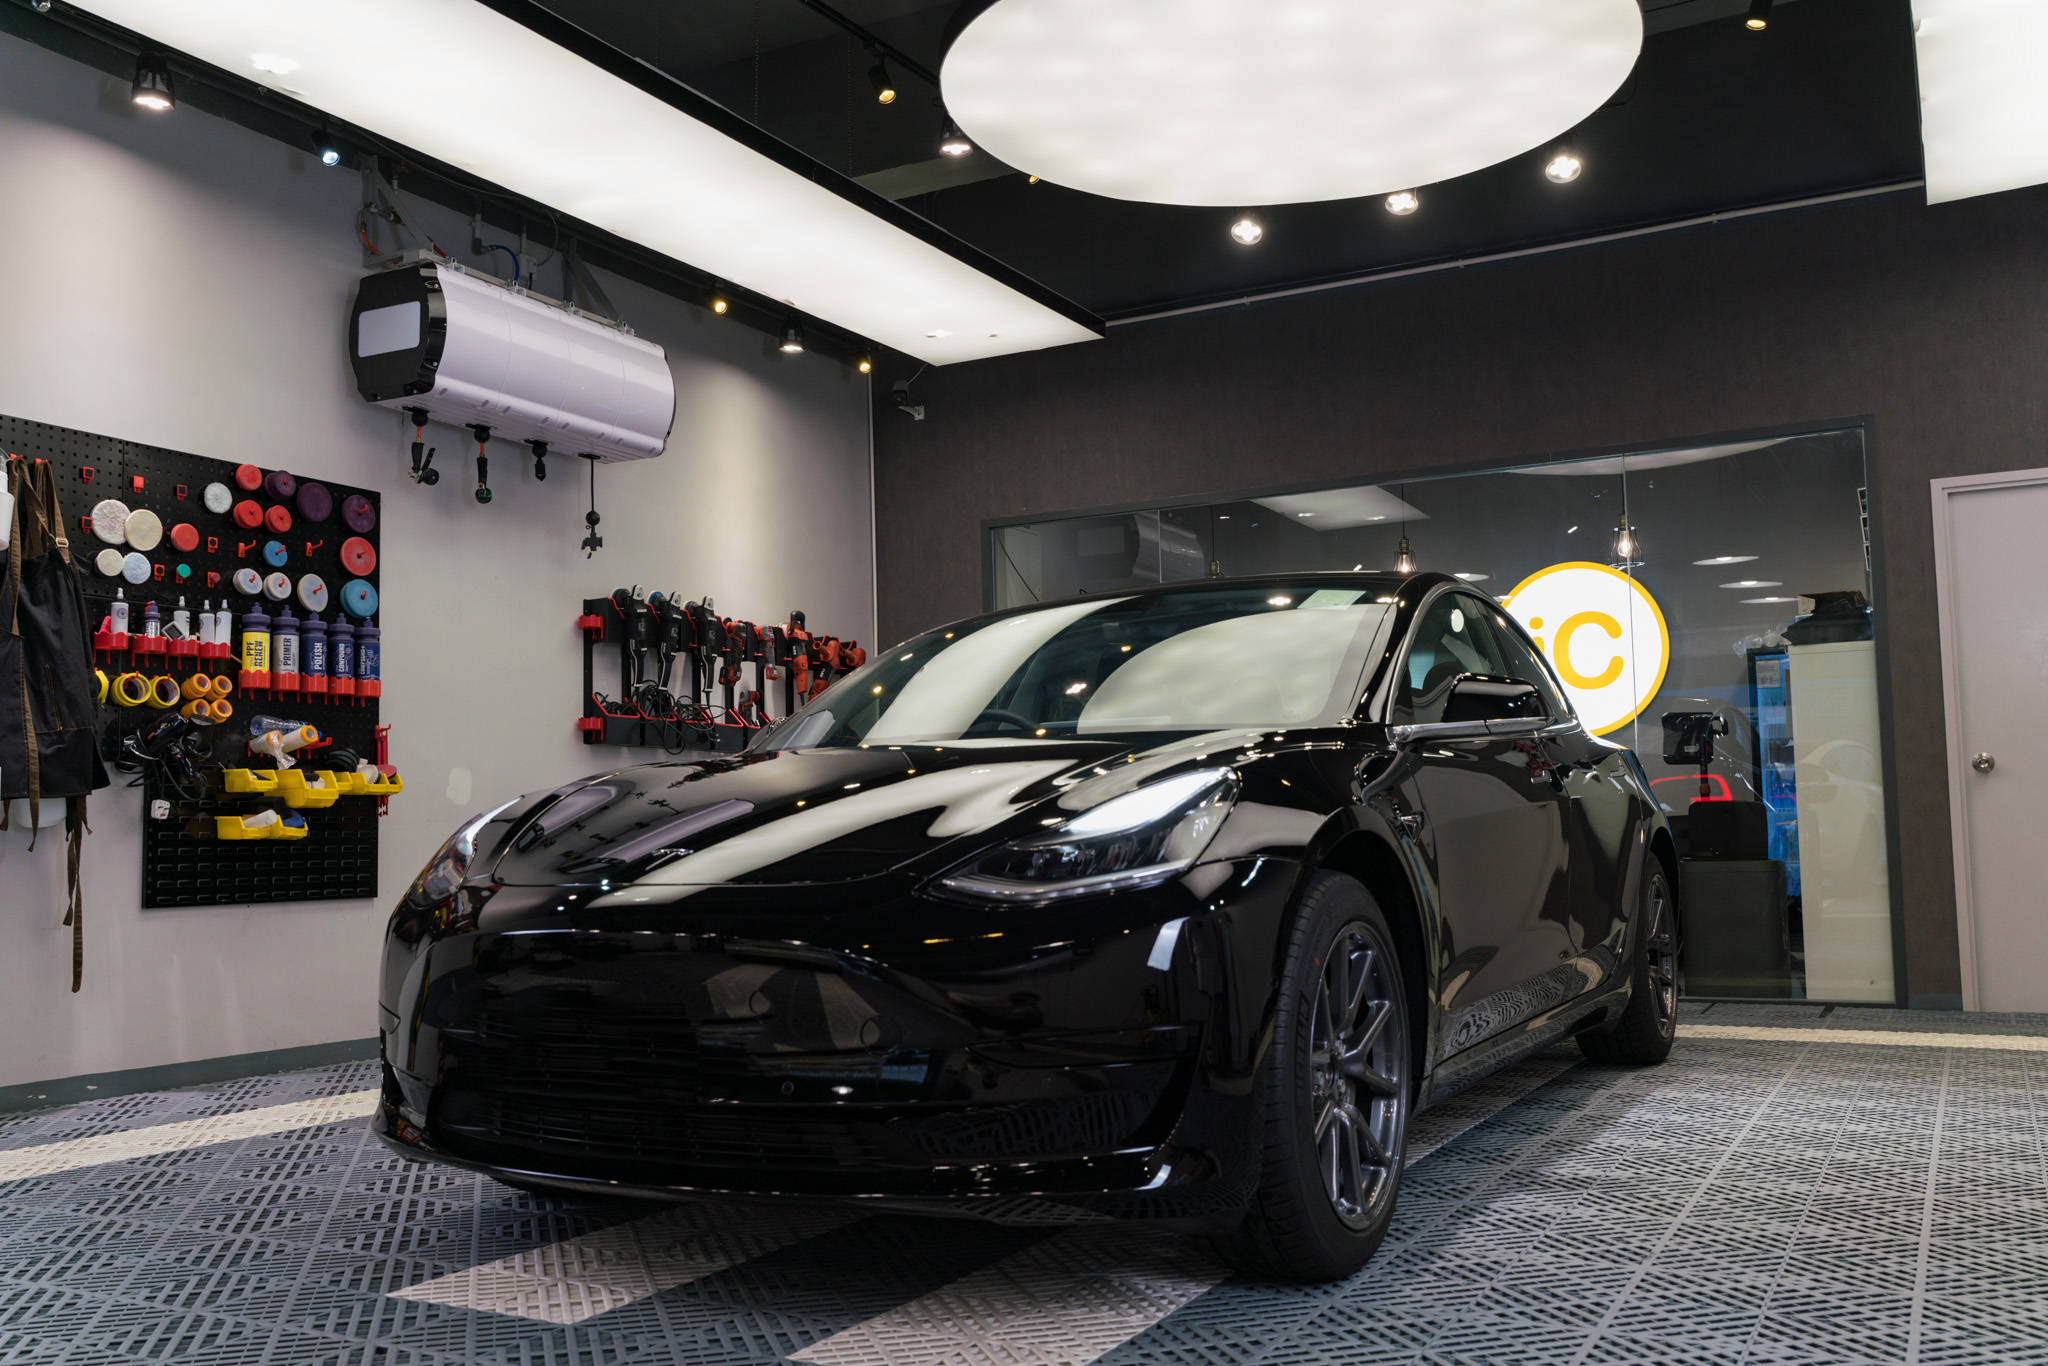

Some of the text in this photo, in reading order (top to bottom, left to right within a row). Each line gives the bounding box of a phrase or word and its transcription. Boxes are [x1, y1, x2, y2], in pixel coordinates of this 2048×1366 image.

[246, 641, 254, 656] PPF
[254, 640, 263, 667] RENEW
[283, 637, 291, 666] PRIMER
[314, 642, 322, 670] POLISH
